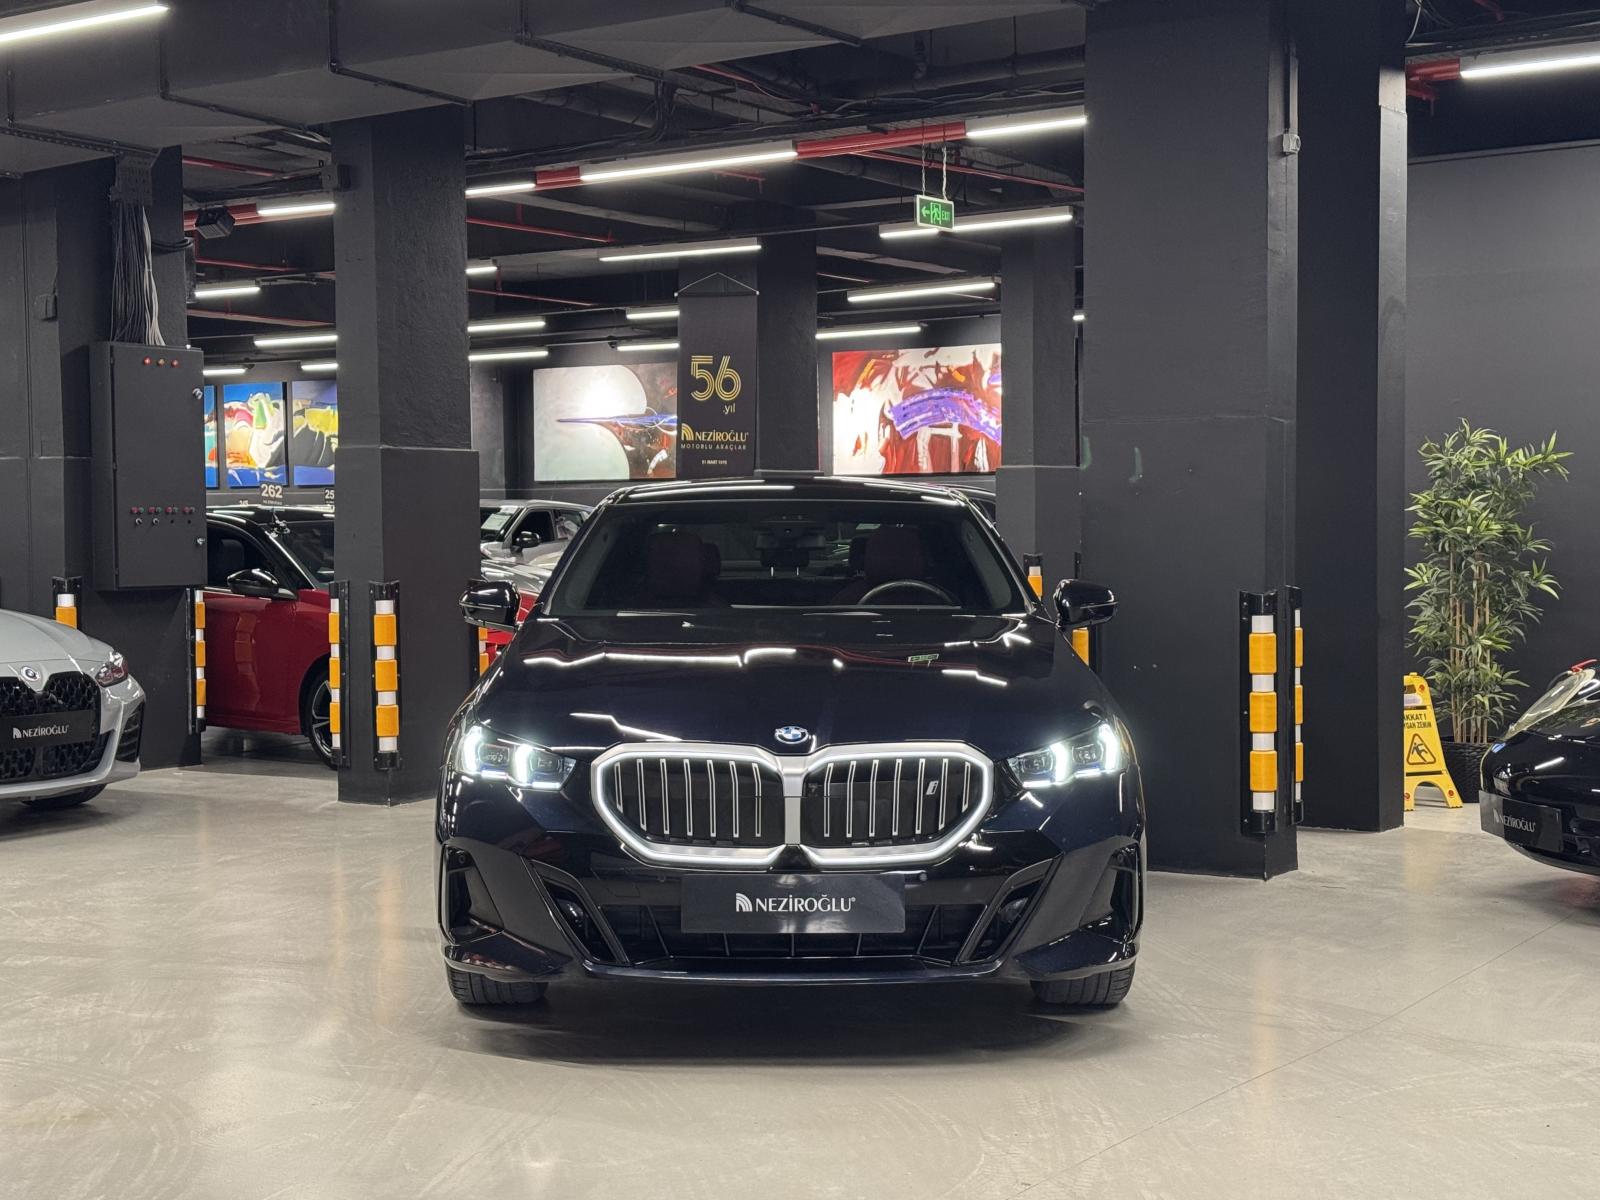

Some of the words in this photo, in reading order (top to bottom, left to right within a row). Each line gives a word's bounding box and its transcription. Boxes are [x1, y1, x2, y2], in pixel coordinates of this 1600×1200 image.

[690, 355, 742, 401] 56
[695, 429, 747, 442] NEZİROĞLU
[261, 483, 283, 499] 262
[325, 489, 335, 500] 25
[1404, 713, 1423, 721] KKAT
[22, 725, 68, 738] NEZİROĞLU
[756, 894, 852, 912] NEZİROĞLU
